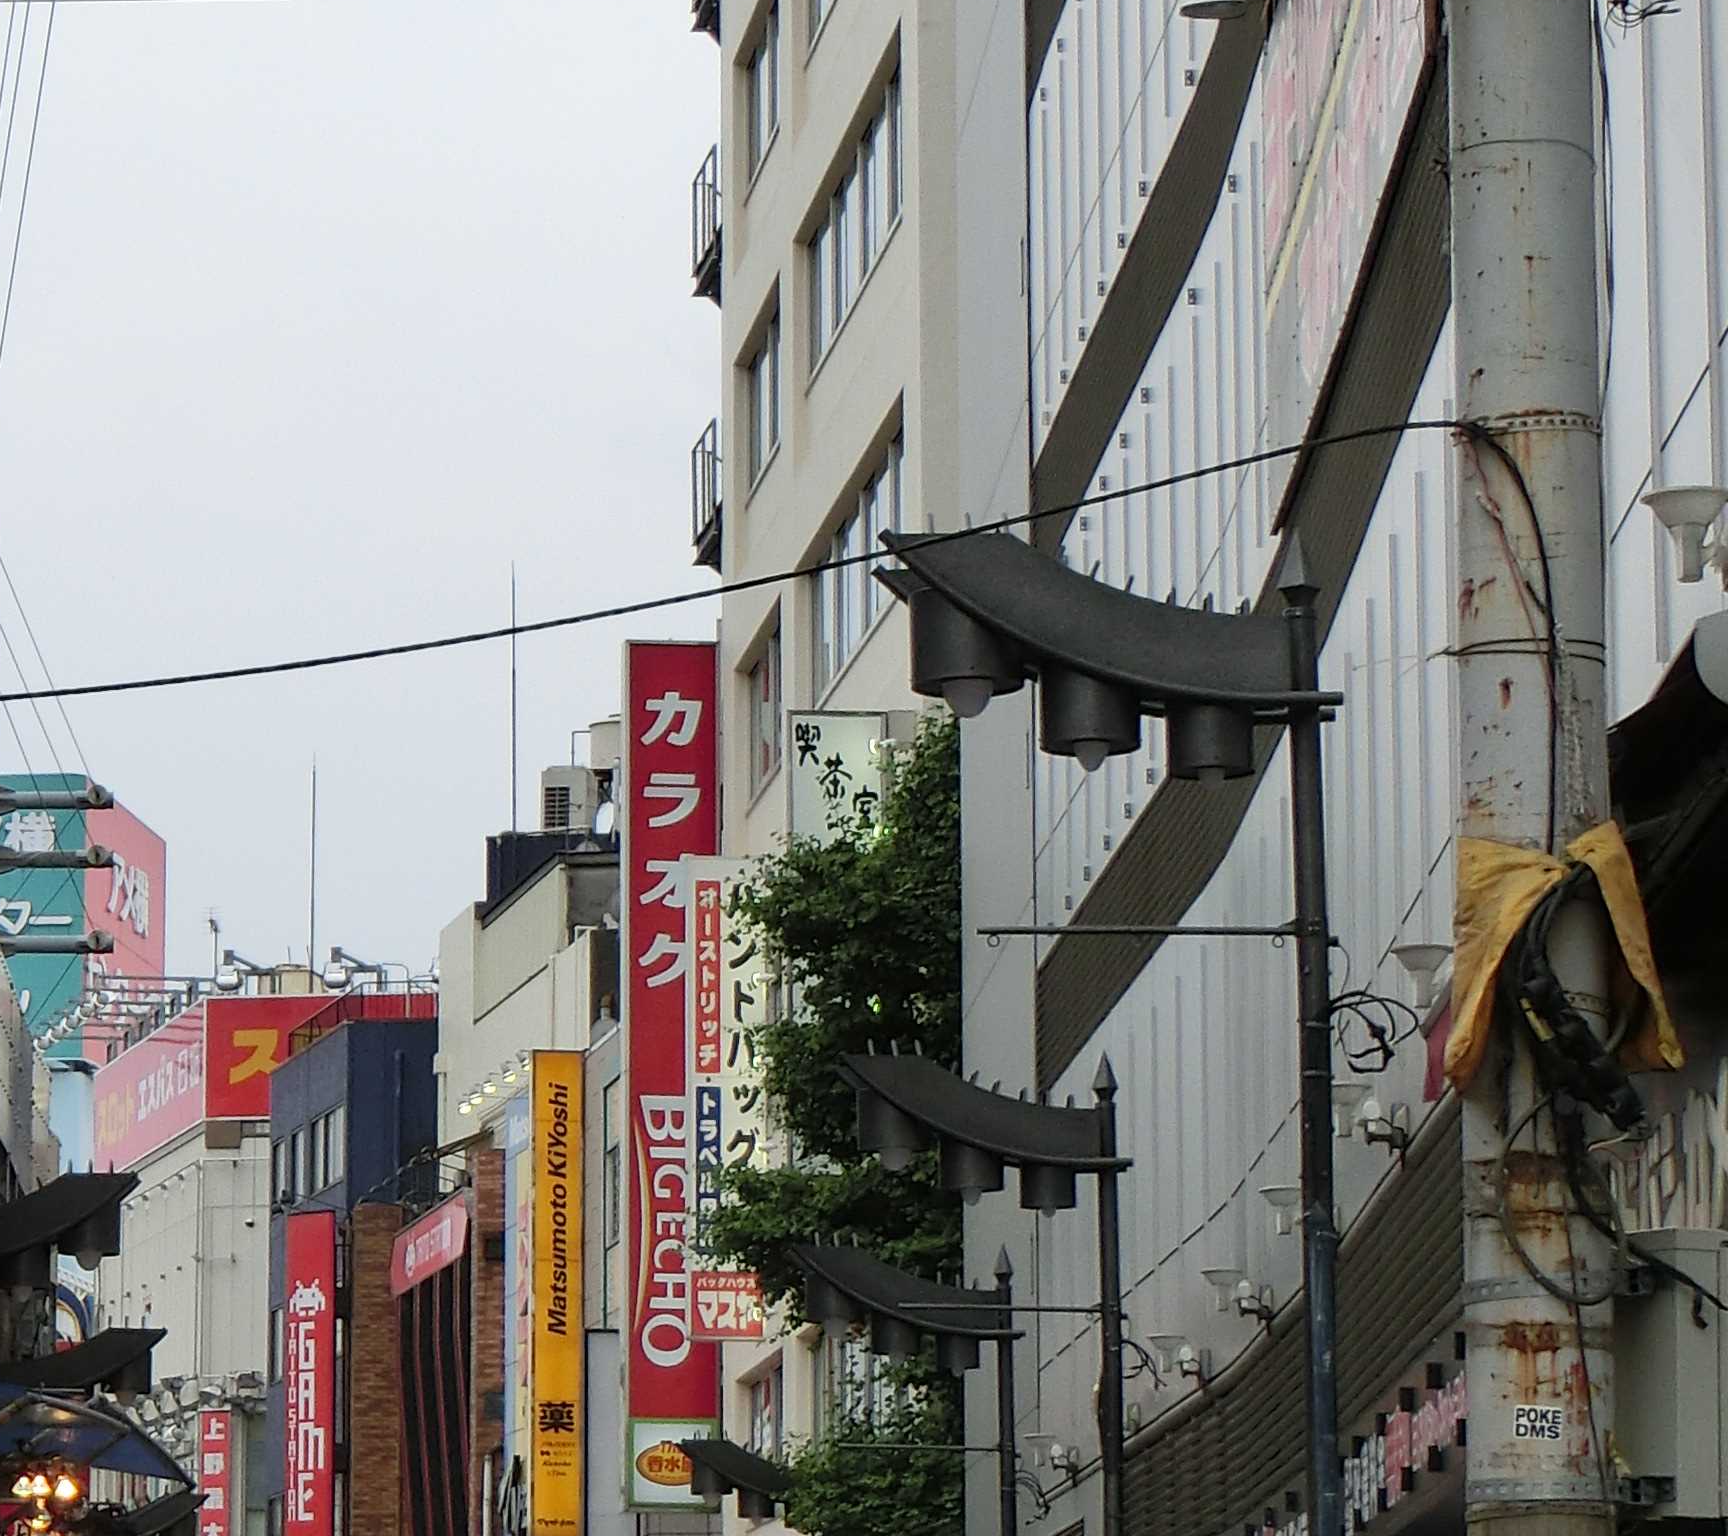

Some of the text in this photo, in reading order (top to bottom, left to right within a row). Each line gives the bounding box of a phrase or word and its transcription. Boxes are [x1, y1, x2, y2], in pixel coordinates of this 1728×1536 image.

[698, 887, 719, 1068] オーストリッチ
[547, 1183, 568, 1336] Matsumoto
[639, 1094, 693, 1366] BIG ECHO
[288, 1322, 296, 1521] TAITO STATION
[298, 1321, 325, 1522] GAME
[538, 1401, 575, 1434] 薬
[1515, 1407, 1562, 1425] POKE
[1515, 1424, 1560, 1439] DMS
